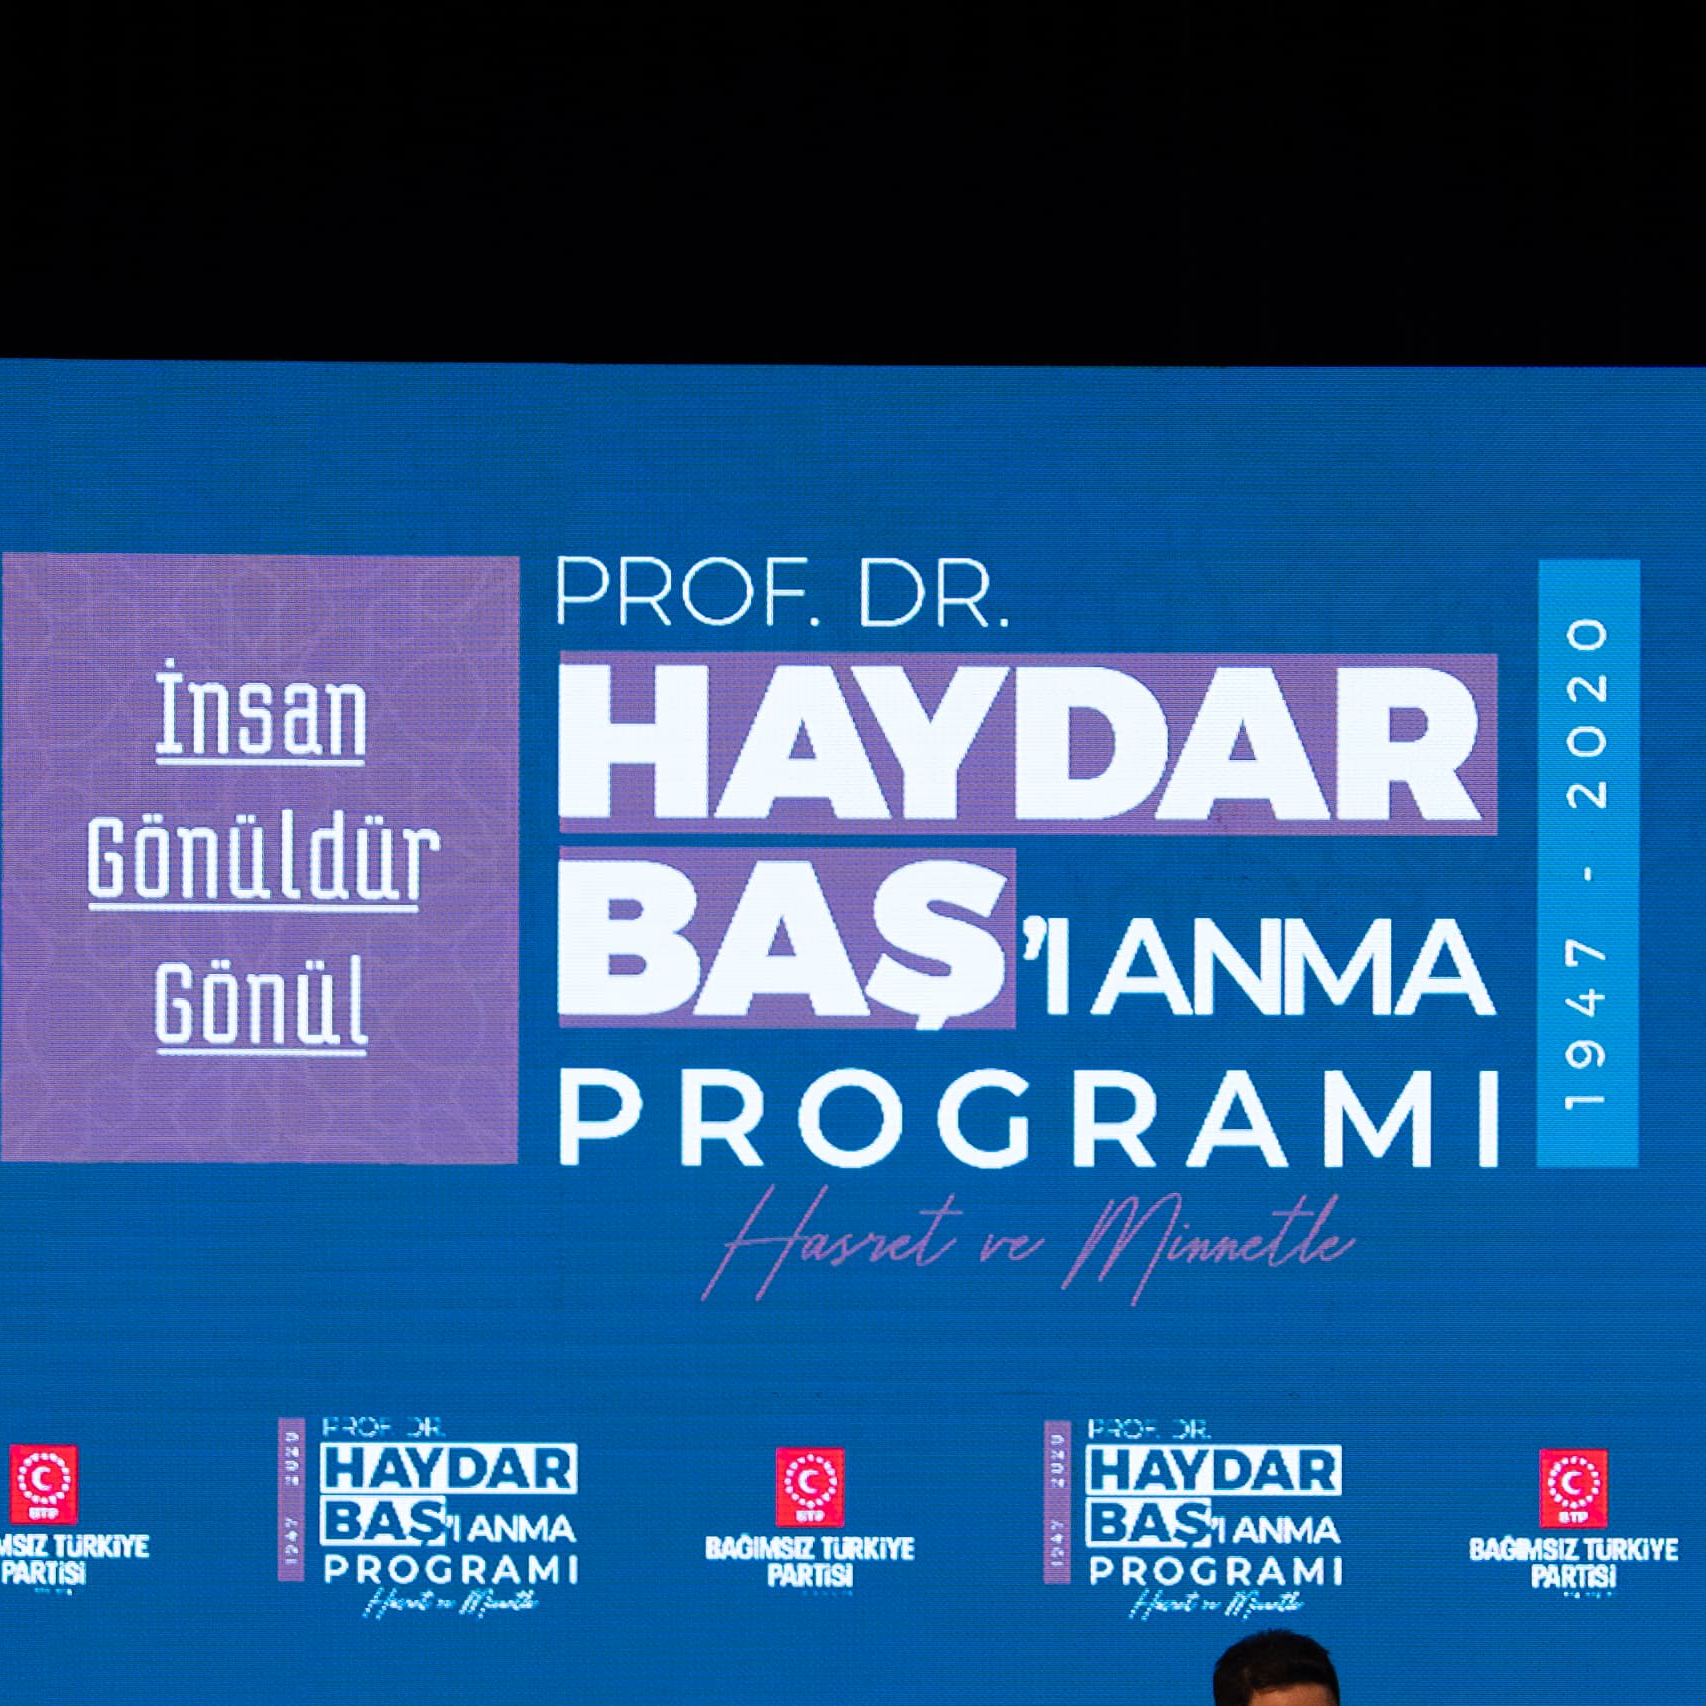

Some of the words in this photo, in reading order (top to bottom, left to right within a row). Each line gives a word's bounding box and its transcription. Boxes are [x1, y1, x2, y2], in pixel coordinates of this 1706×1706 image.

[557, 556, 819, 626] PROF.
[861, 557, 1009, 627] DR.
[155, 658, 367, 755] İnsan
[558, 664, 1483, 820] HAYDAR
[1566, 618, 1607, 809] 2020
[88, 809, 440, 899] Gönüldür
[155, 955, 369, 1045] Gönül
[1089, 917, 1497, 1015] ANMA
[1565, 938, 1606, 1110] 1947
[559, 1068, 1499, 1168] PROGRAMI
[700, 1184, 964, 1301] Hasret
[979, 1233, 1045, 1262] ve
[1060, 1192, 1356, 1307] Minnetle
[326, 1447, 571, 1488] HAYDAR
[1091, 1449, 1336, 1490] HAYDAR
[325, 1555, 577, 1584] PROGRAMI
[468, 1515, 575, 1542] ANMA
[1090, 1557, 1342, 1585] PROGRAMI
[1233, 1517, 1340, 1543] ANMA
